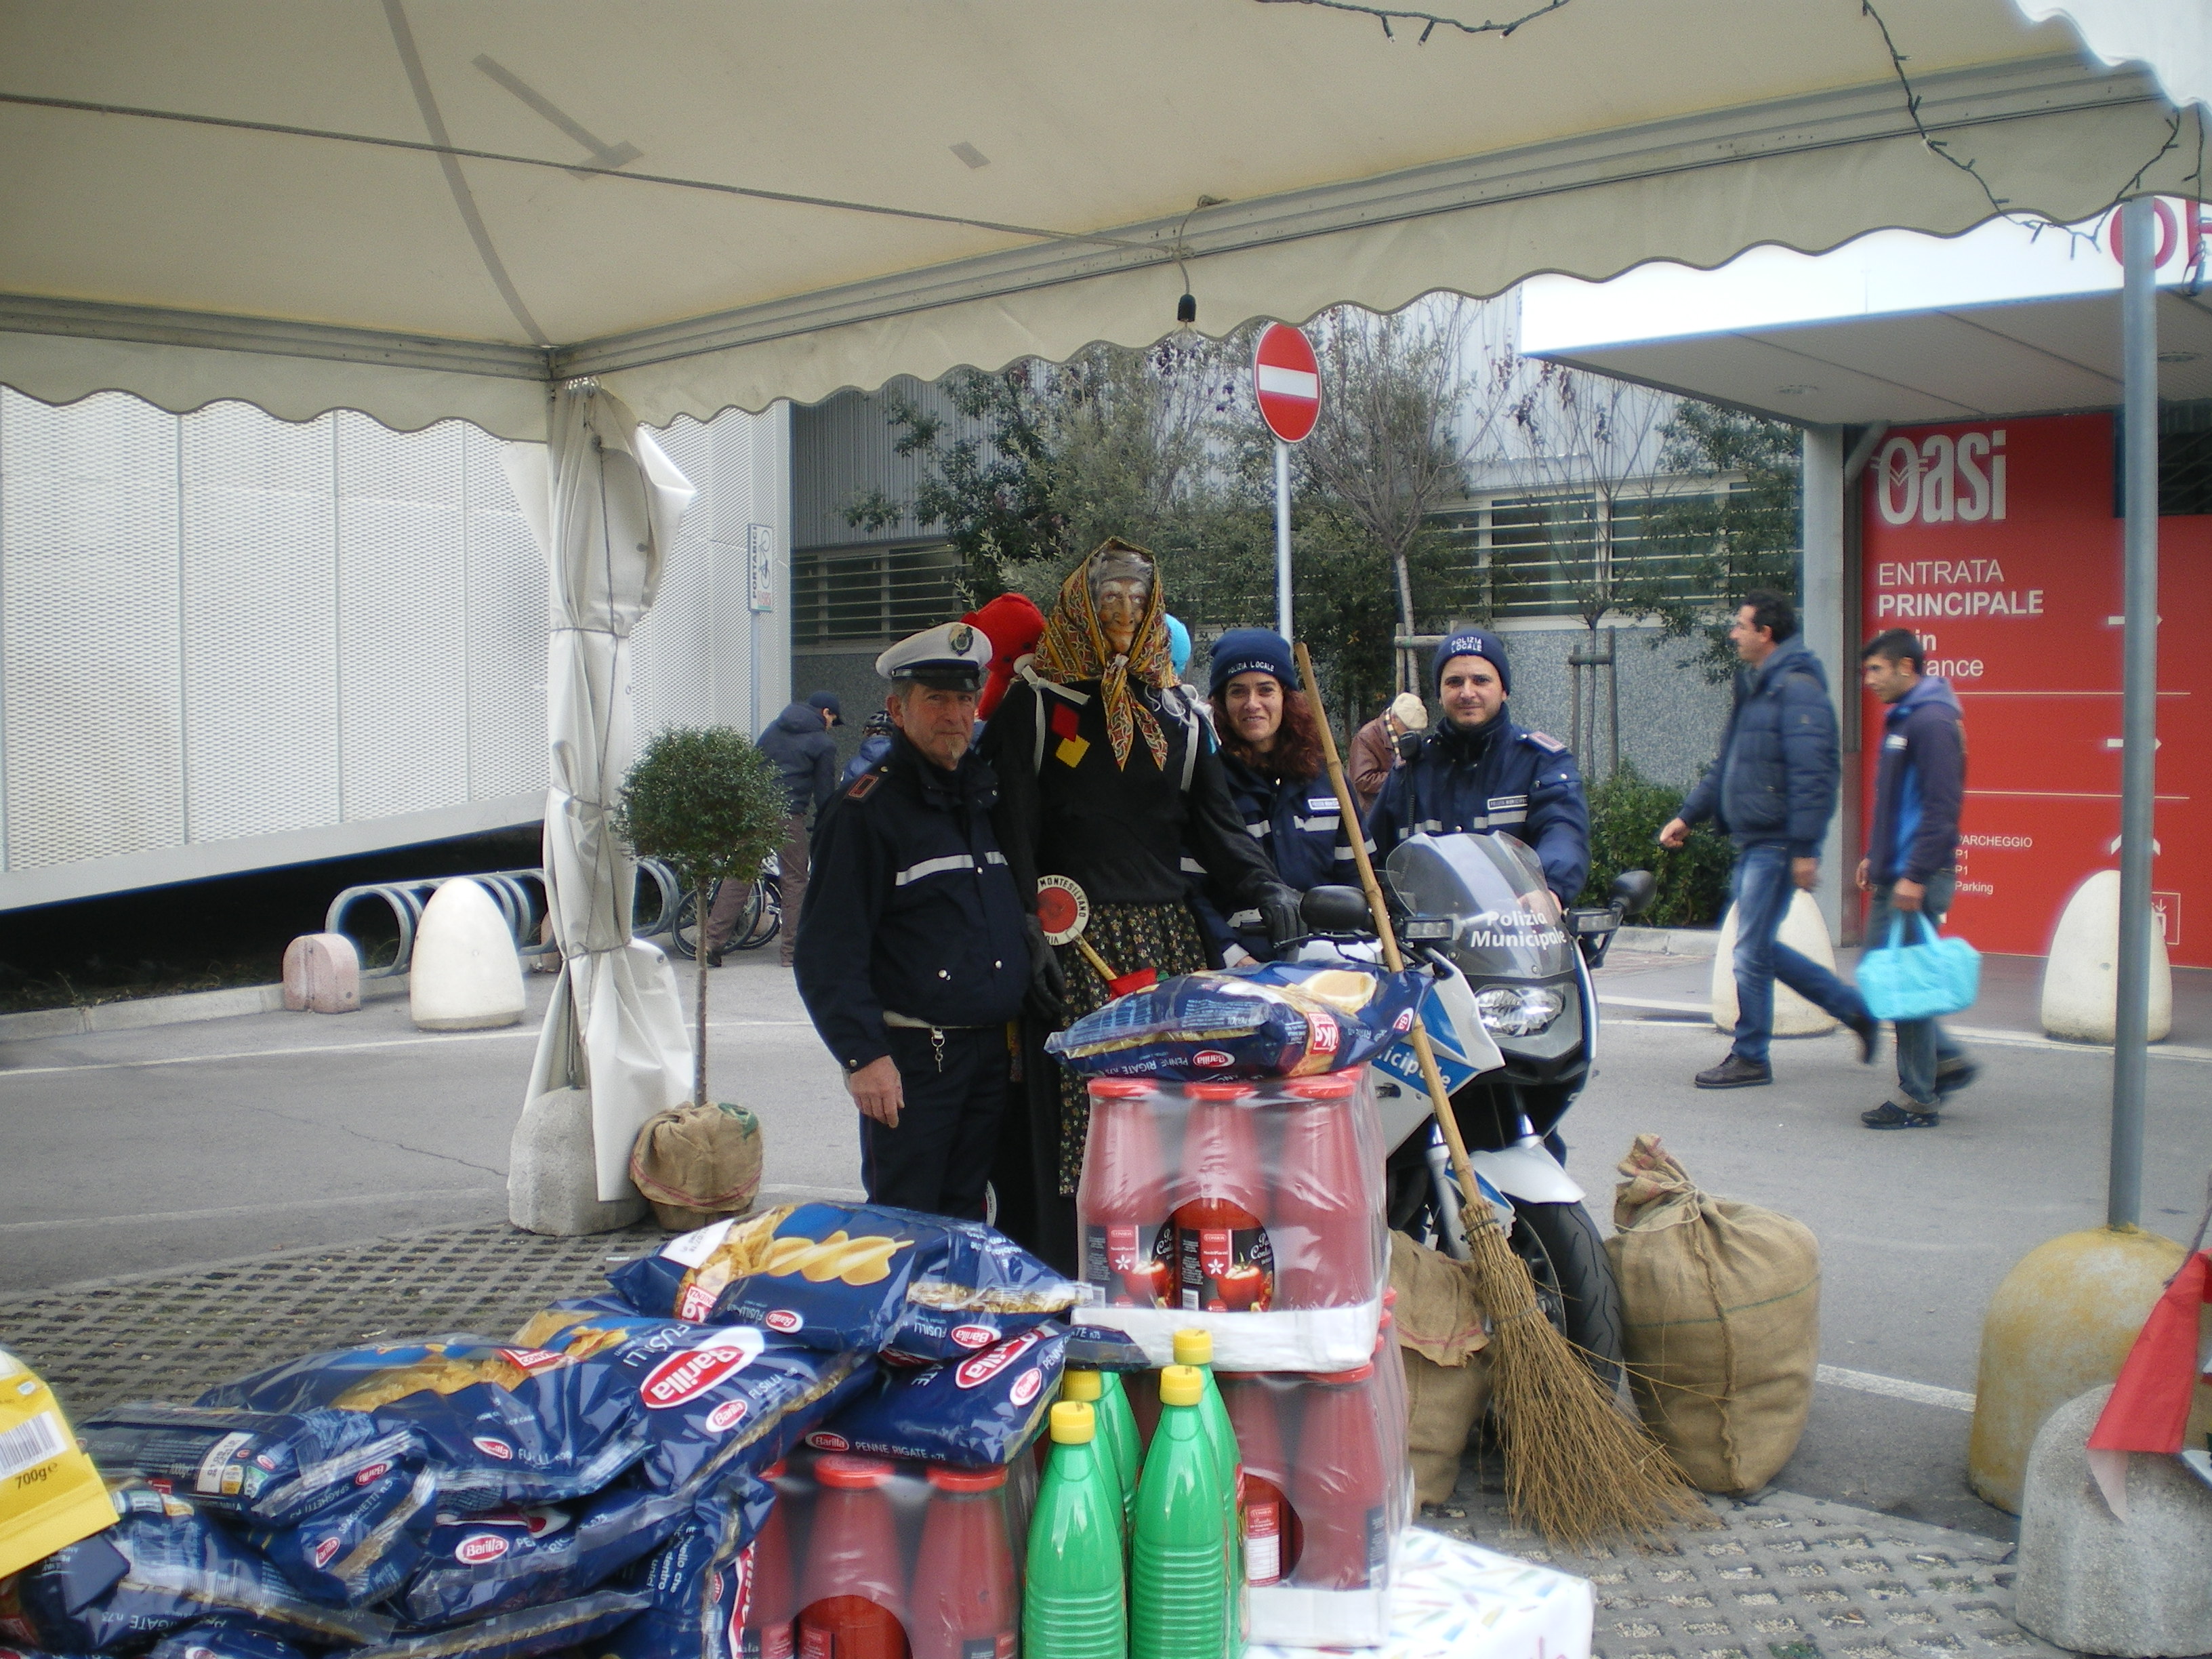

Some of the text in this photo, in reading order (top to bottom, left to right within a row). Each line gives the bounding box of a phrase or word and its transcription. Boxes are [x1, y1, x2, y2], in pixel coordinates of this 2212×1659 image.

[1879, 560, 2004, 586] ENTRATA
[1879, 590, 2043, 617] PRINCIPALE
[1451, 643, 1483, 654] LOCALE
[1452, 636, 1483, 647] POLIZIA
[1250, 661, 1275, 672] LOCALE
[1955, 848, 1968, 860] P1
[1955, 865, 1968, 876] P1
[1955, 881, 1993, 895] Parking
[1040, 877, 1087, 918] MONTESILVANO
[1487, 909, 1548, 926] Polizia
[1470, 926, 1567, 951] Municipale
[1121, 1059, 1158, 1075] RIGATE
[1161, 1057, 1189, 1067] PENNE
[1196, 1054, 1226, 1065] Barilla
[769, 1312, 796, 1328] Barilla
[914, 1322, 947, 1339] FUSILLI
[956, 1330, 990, 1344] Barilla
[623, 1324, 691, 1368] FUSILLI
[1042, 1341, 1065, 1370] PENNE
[650, 1349, 739, 1401] Barilla
[747, 1374, 783, 1399] FUSILLI
[1017, 1370, 1040, 1399] Barilla
[714, 1402, 744, 1427] Barilla
[815, 1435, 848, 1450] Barilla
[854, 1441, 889, 1455] PENNE
[892, 1445, 928, 1459] RIGATE
[15, 1469, 47, 1490] 700g
[359, 1464, 386, 1482] Barilla
[337, 1492, 381, 1535] SPAGHETTI
[314, 1538, 339, 1561] arilla
[466, 1539, 504, 1557] Barilla
[645, 1559, 659, 1587] unici
[657, 1551, 674, 1591] dentro
[670, 1572, 682, 1594] che
[129, 1614, 173, 1631] GATE
